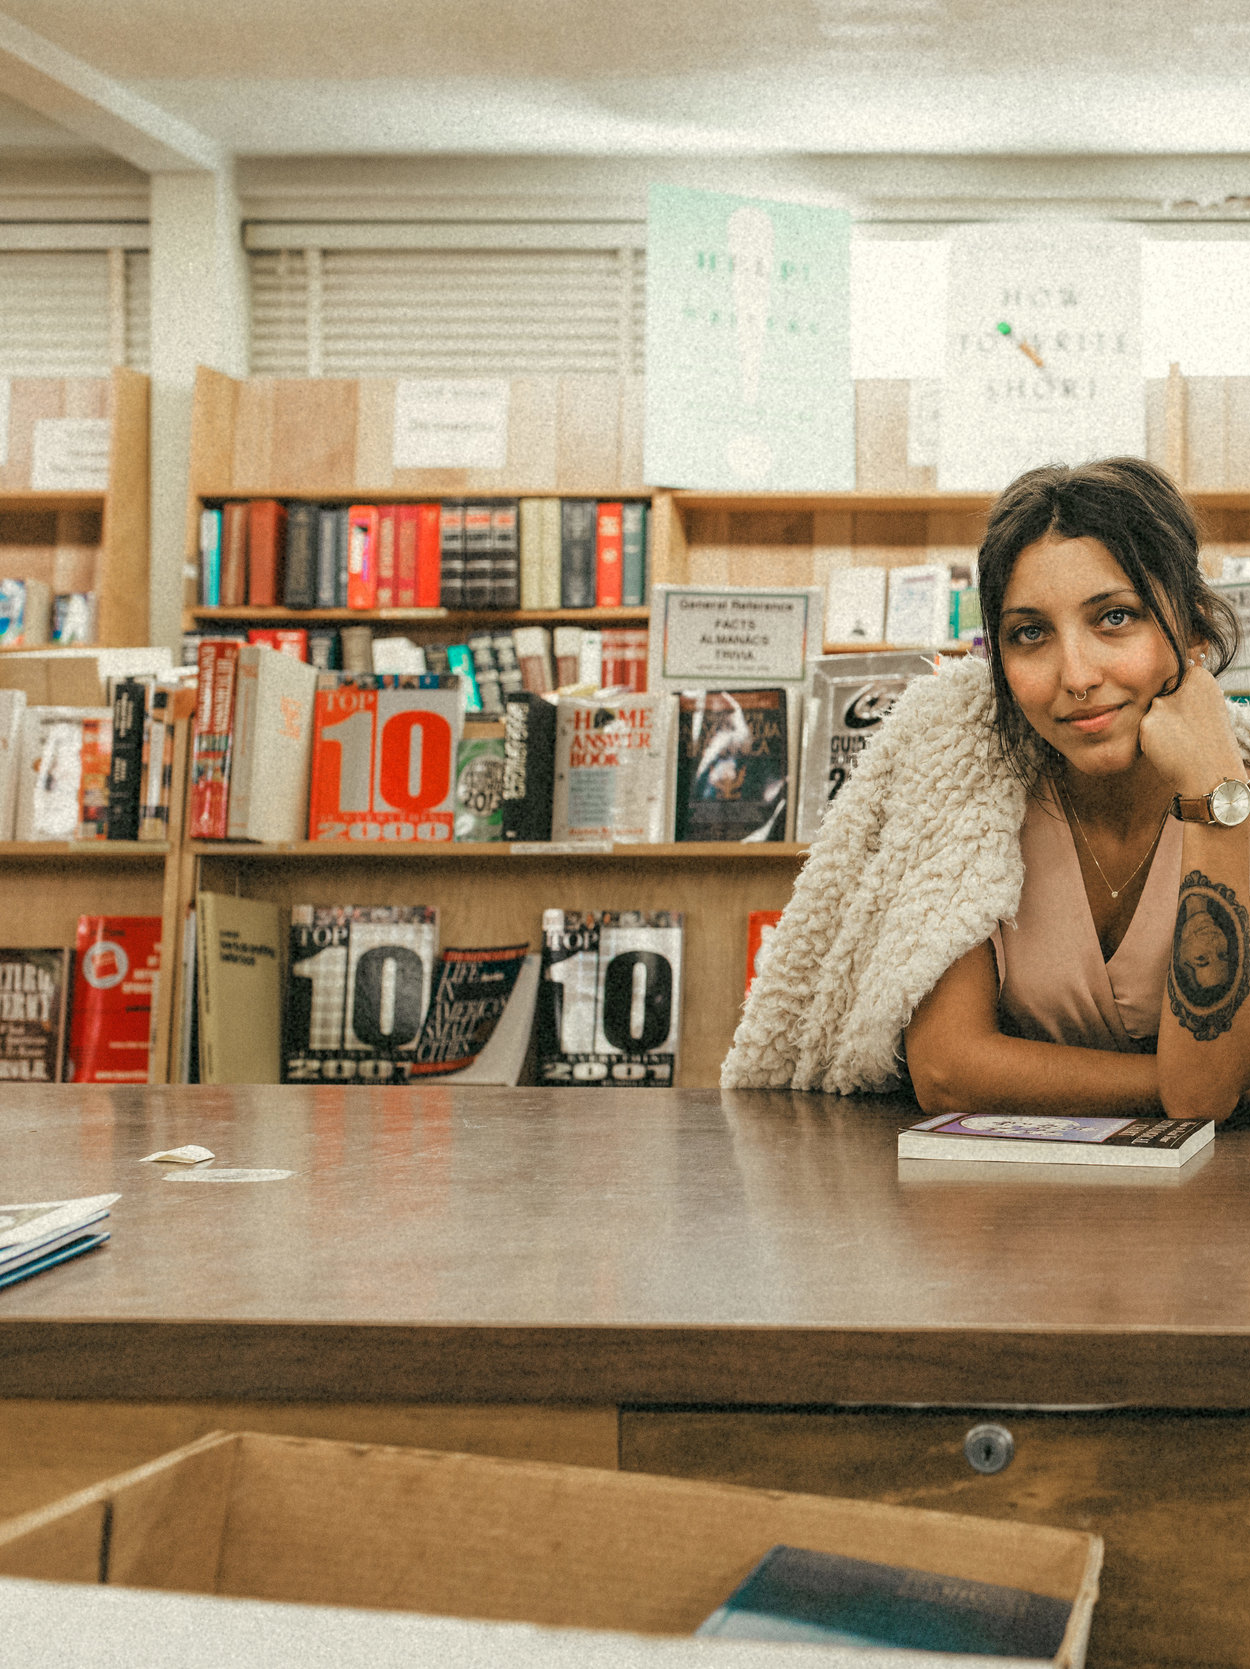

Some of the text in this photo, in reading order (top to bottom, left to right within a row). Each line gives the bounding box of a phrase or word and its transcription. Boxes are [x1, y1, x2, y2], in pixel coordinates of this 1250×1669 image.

[679, 599, 793, 612] General Reference
[715, 618, 756, 631] FACTS
[699, 634, 769, 646] ALMANACS
[715, 649, 755, 661] TRIVIA
[323, 690, 375, 712] TOP
[318, 709, 452, 813] 10
[569, 750, 620, 767] BOOK
[317, 822, 450, 841] 2000
[299, 926, 349, 947] TOP
[546, 930, 598, 951] TOP
[292, 945, 424, 1050] 10
[548, 950, 673, 1055] 10
[544, 1062, 671, 1080] 2001
